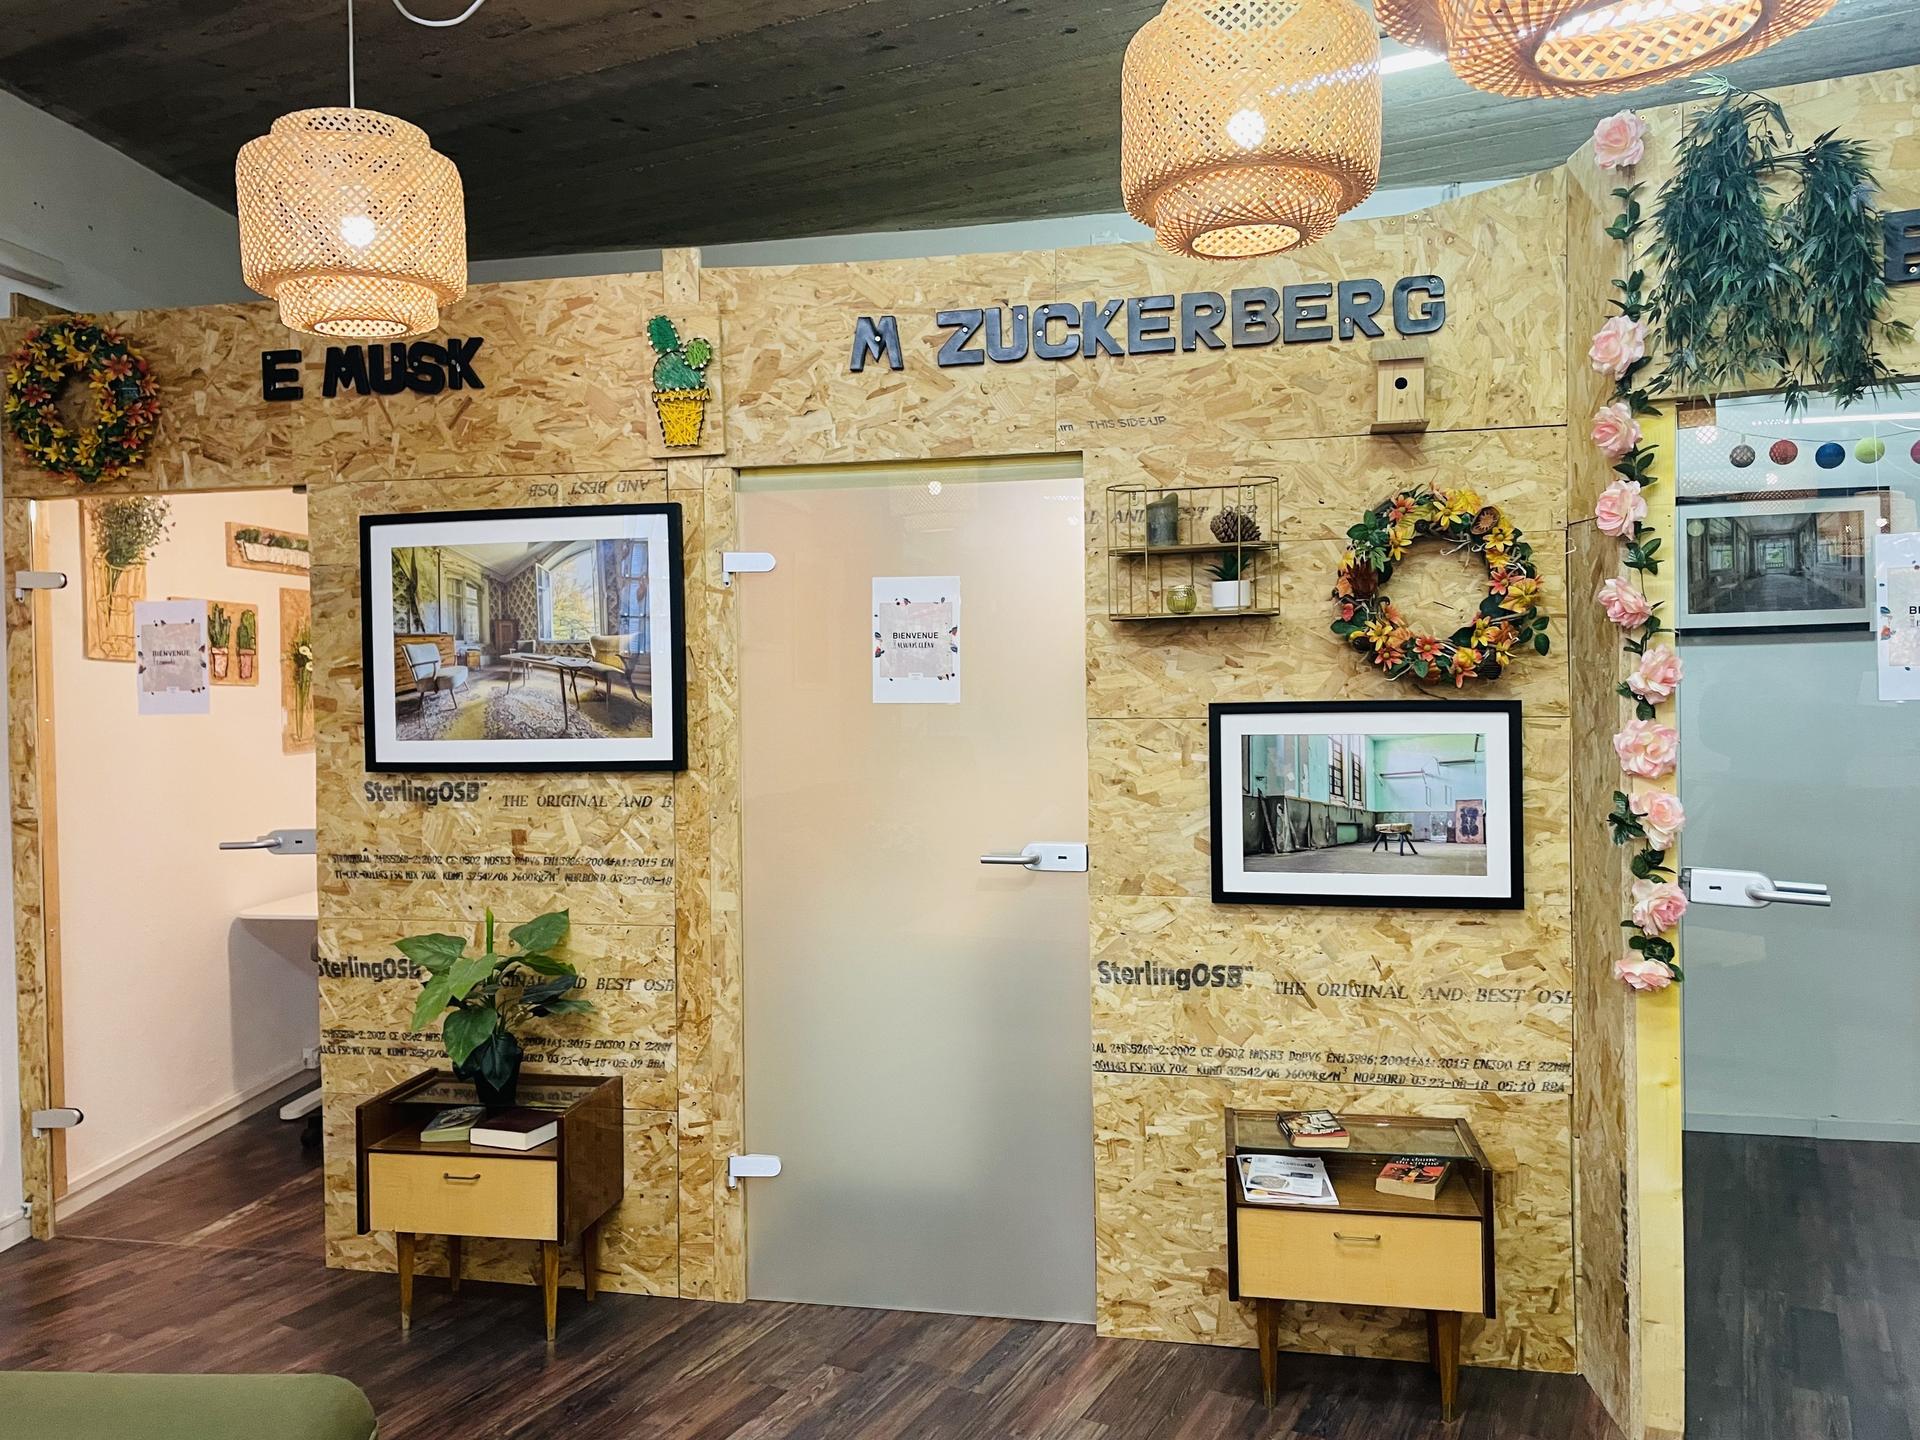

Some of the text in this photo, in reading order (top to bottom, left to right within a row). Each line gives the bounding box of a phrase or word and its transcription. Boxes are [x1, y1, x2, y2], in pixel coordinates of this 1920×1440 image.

[850, 274, 1447, 372] M ZUCKERBERG
[261, 337, 485, 401] E MUSK
[1087, 419, 1115, 430] THIS
[1117, 417, 1145, 428] SIDE
[528, 479, 650, 497] AND BEST OSB
[502, 794, 528, 808] THE
[536, 795, 608, 808] ORIGINAL
[617, 795, 653, 808] AND
[596, 977, 633, 991] BEST
[643, 978, 675, 992] OSB
[1273, 981, 1306, 995] THE
[1316, 982, 1409, 999] ORIGINAL
[1421, 986, 1464, 1001] AND
[1475, 987, 1526, 1003] BEST
[1200, 1046, 1213, 1057] CE
[1217, 1047, 1245, 1059] 0502
